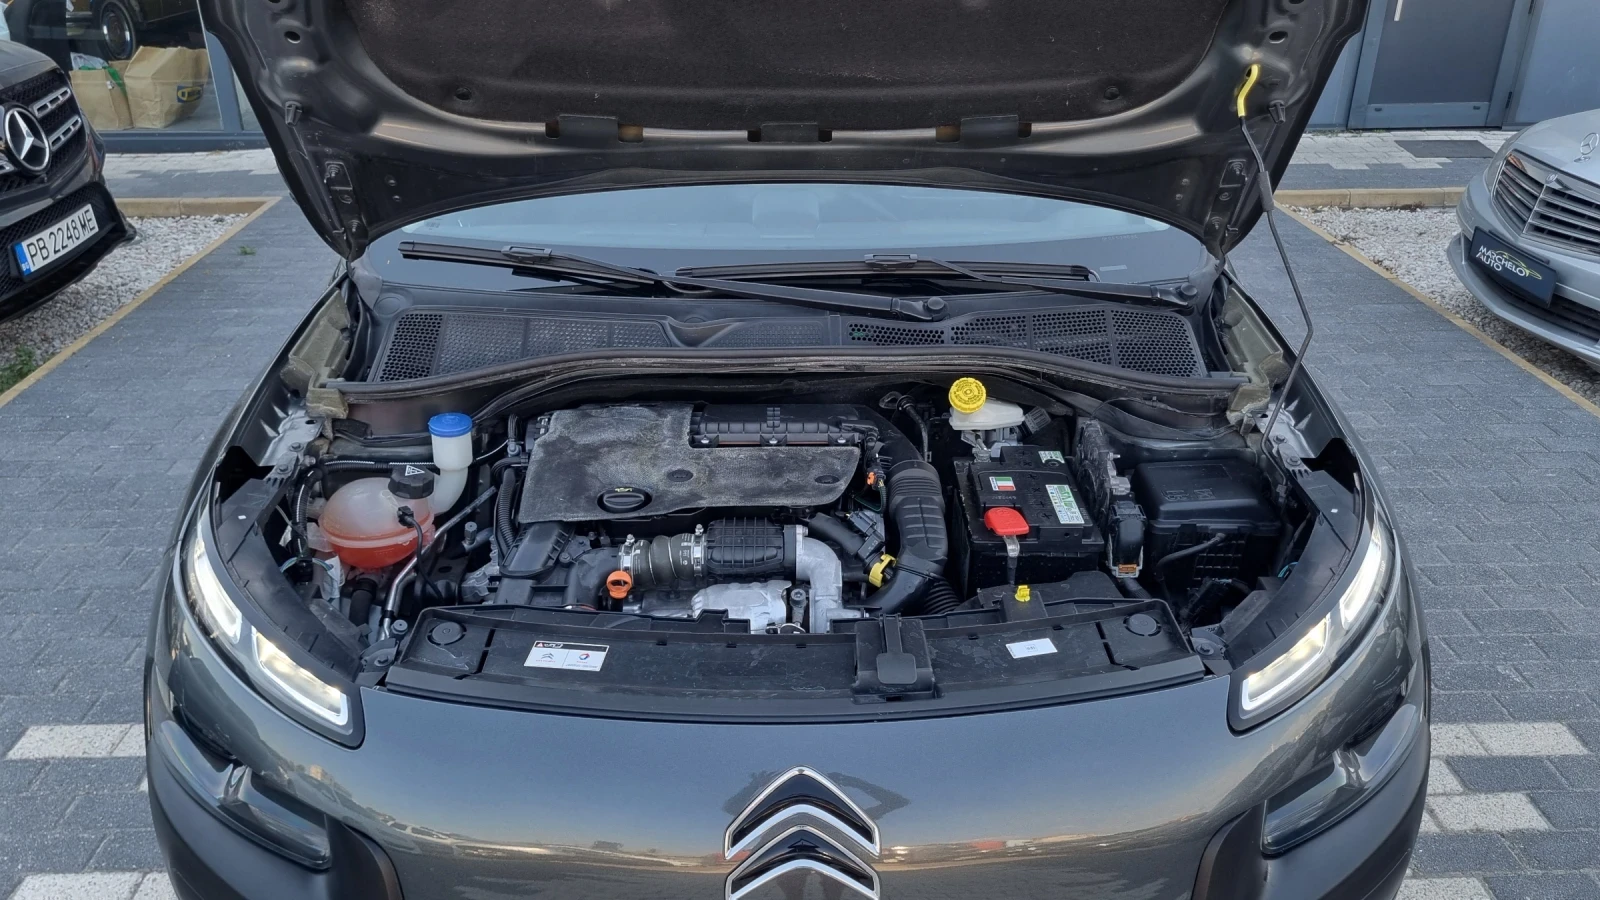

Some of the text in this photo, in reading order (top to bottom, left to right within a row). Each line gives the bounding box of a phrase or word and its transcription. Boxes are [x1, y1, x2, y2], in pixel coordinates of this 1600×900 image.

[26, 209, 96, 266] PB 2248 ME
[1475, 251, 1503, 272] AUTO
[1478, 245, 1526, 277] MARCHELO
